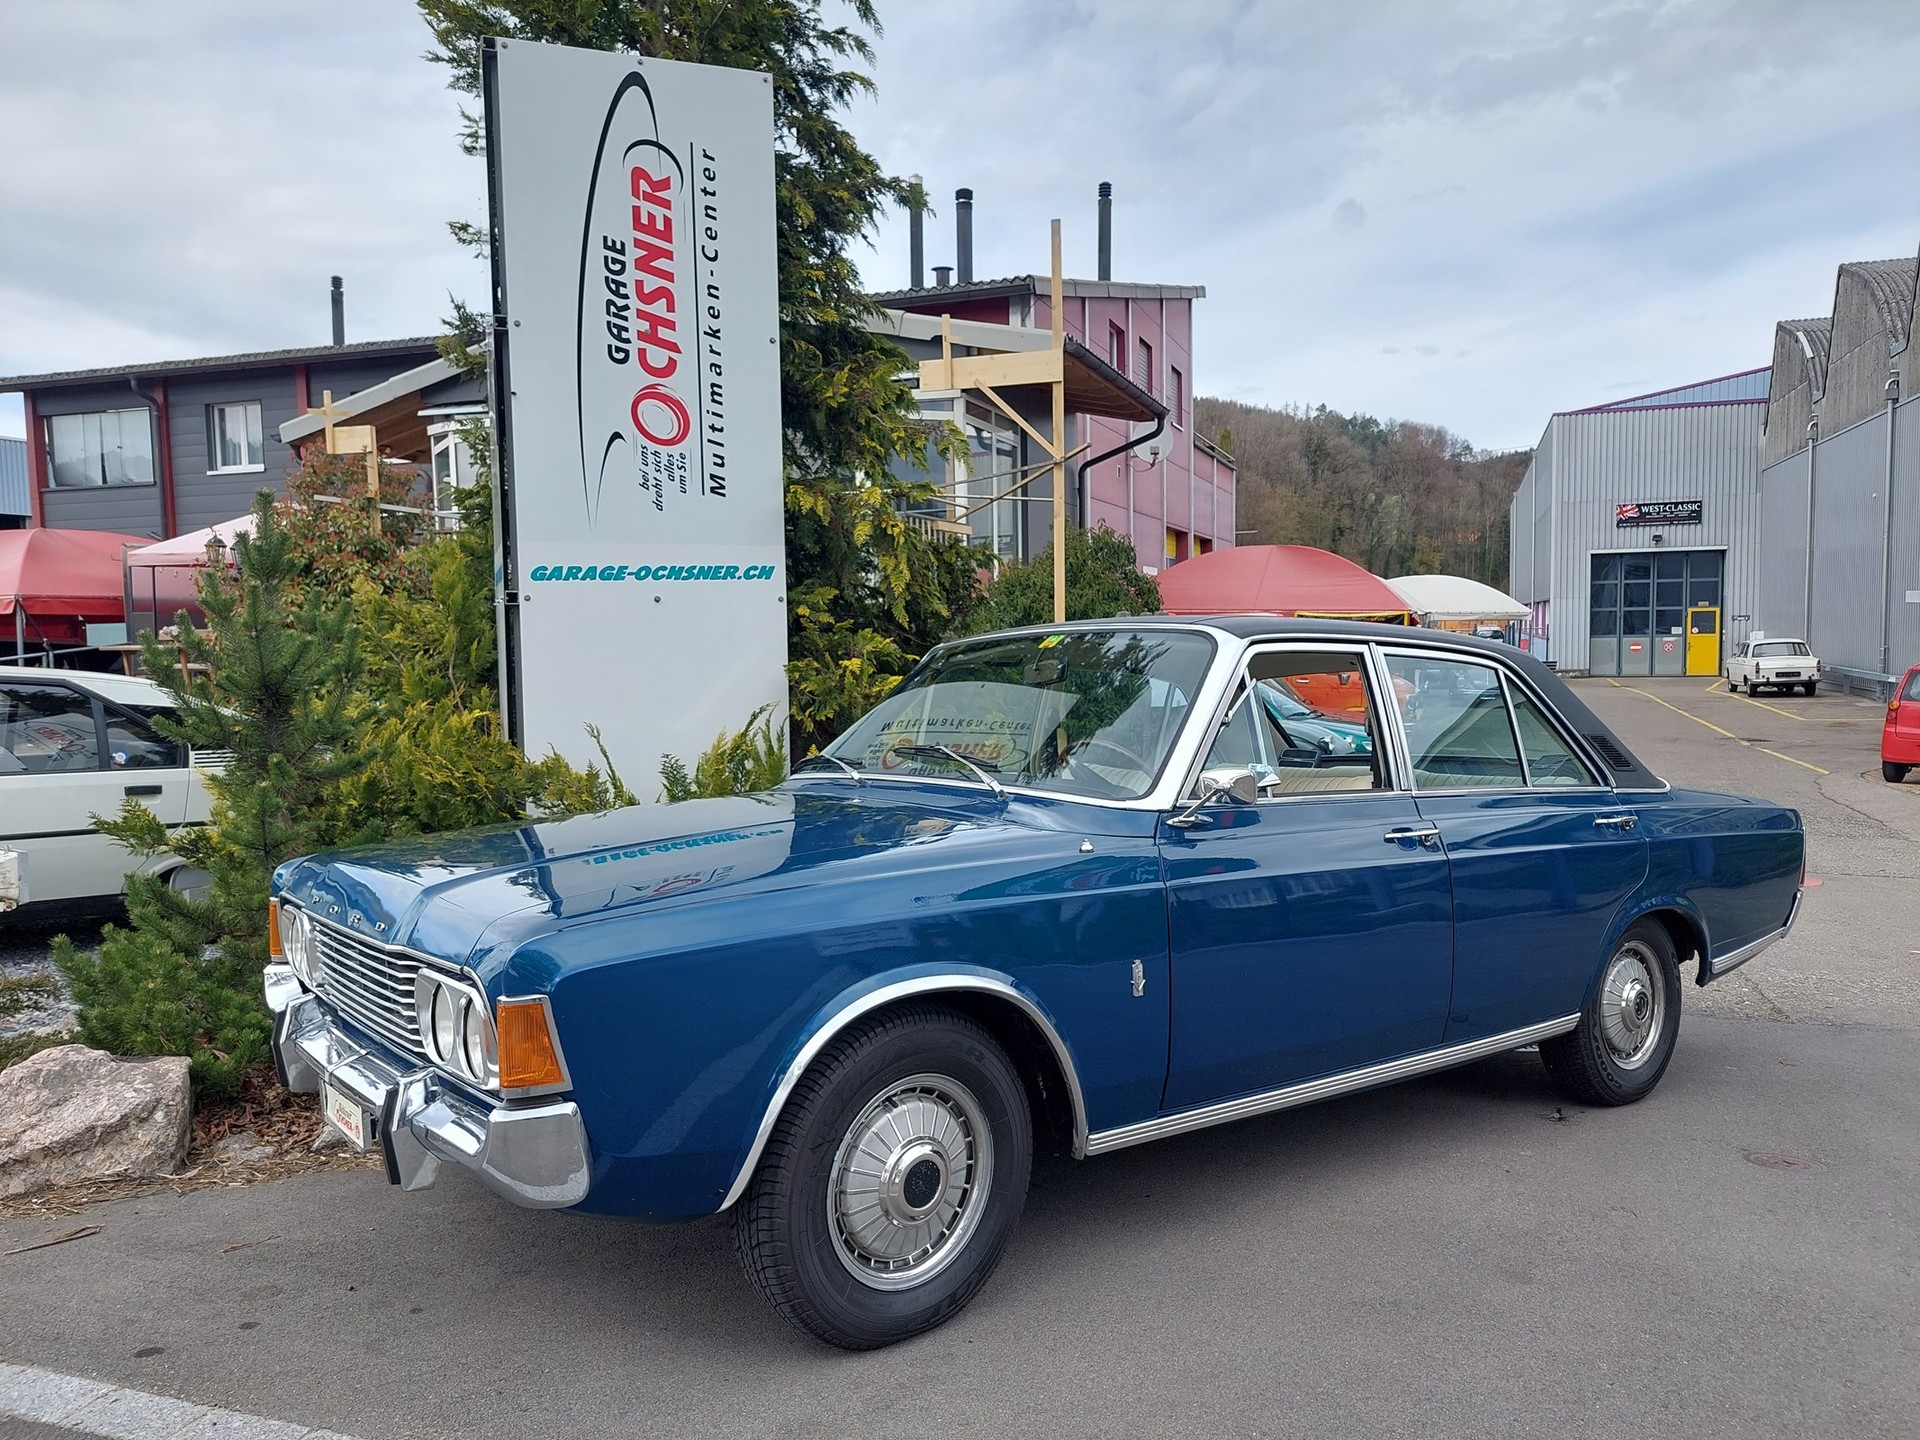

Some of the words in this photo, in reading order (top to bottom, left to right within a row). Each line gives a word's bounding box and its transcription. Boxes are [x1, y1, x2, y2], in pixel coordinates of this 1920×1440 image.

[602, 235, 631, 365] GARAGE
[630, 165, 691, 447] OCHSNER
[699, 148, 727, 498] Multimarken-Center
[640, 443, 649, 467] uns
[650, 450, 662, 475] sich
[663, 452, 675, 482] alles
[676, 452, 687, 473] Sie
[638, 468, 650, 491] bei
[679, 474, 687, 494] um
[651, 476, 663, 512] dreht
[1641, 502, 1702, 513] WEST-CLASSIC
[529, 564, 776, 582] GARAGE-OCHSNER.CH
